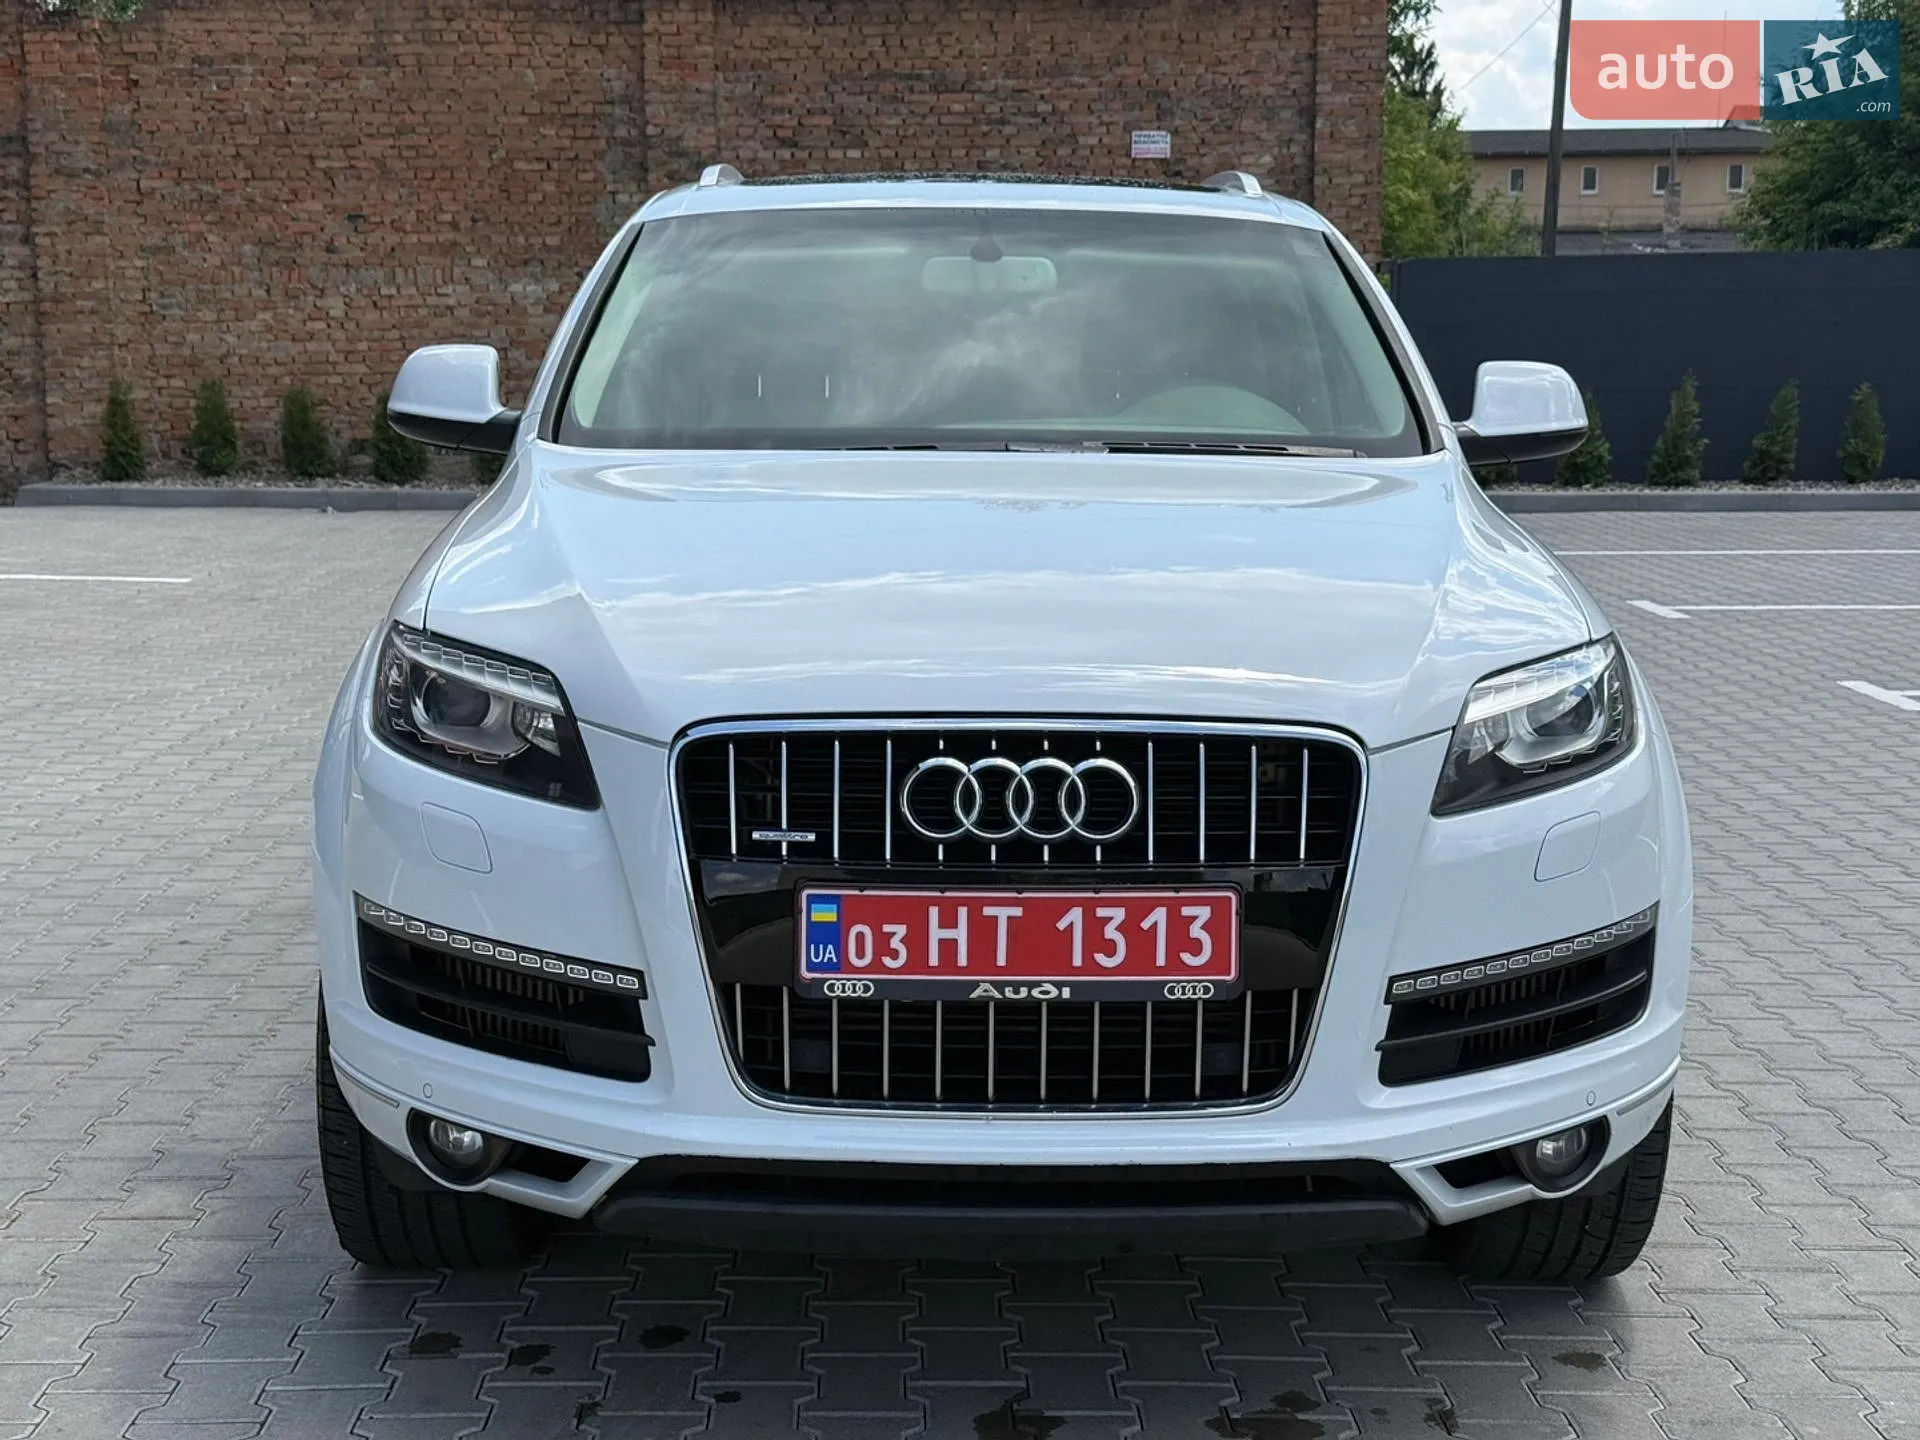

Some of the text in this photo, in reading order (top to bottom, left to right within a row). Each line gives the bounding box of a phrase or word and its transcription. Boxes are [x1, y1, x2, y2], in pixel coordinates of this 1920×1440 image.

[847, 906, 1213, 968] 03 HT 1313
[810, 943, 837, 963] UA
[969, 982, 1071, 999] Audi
